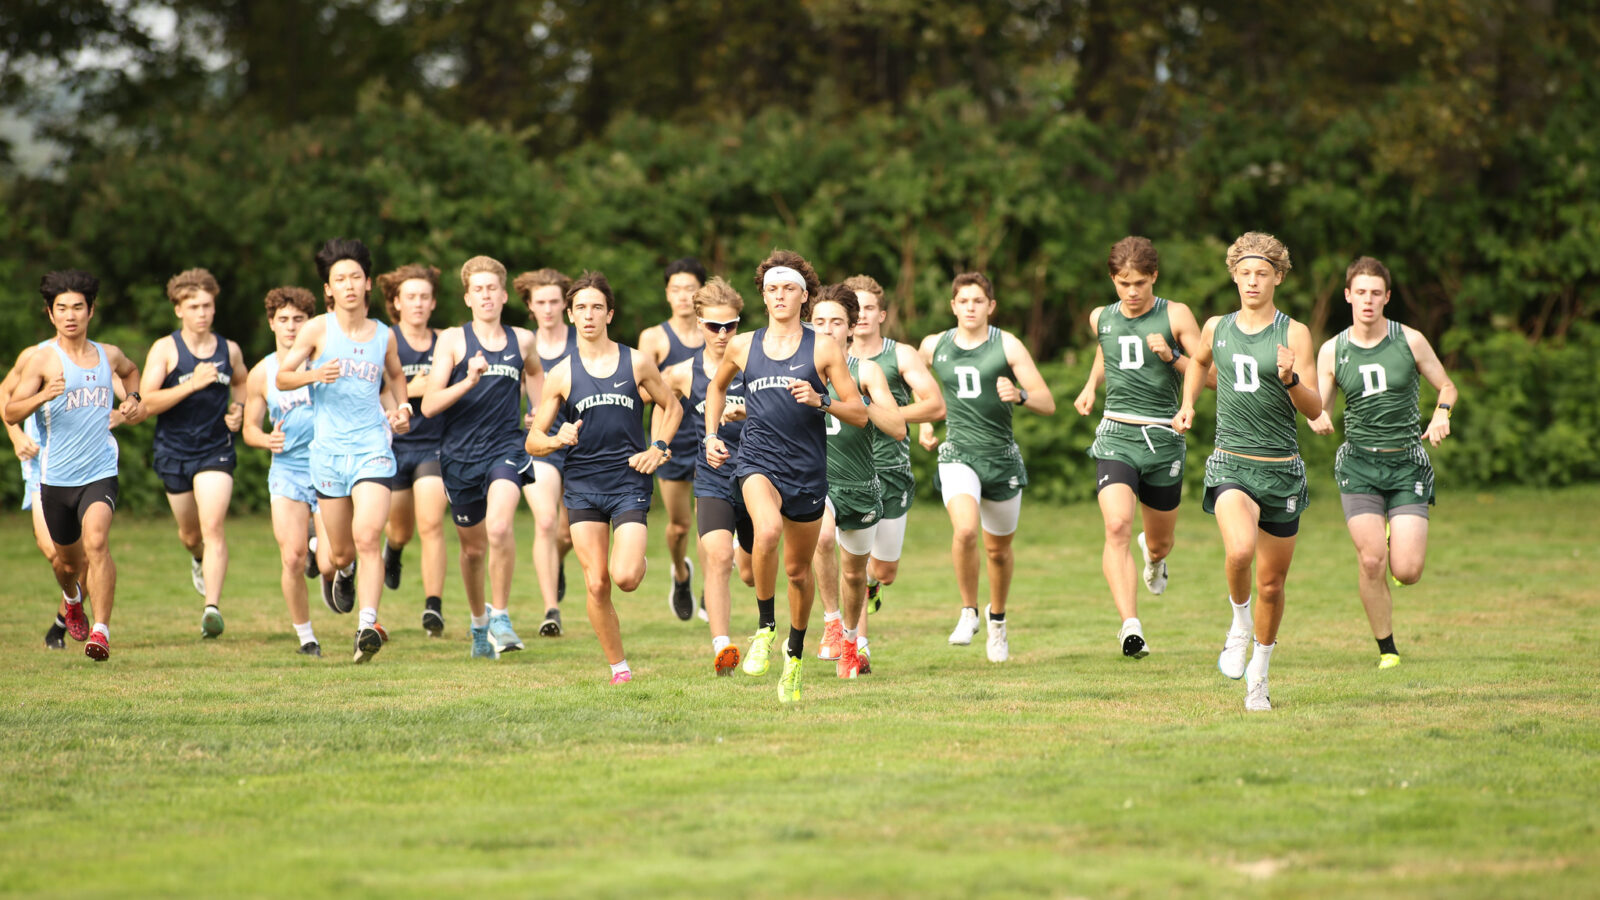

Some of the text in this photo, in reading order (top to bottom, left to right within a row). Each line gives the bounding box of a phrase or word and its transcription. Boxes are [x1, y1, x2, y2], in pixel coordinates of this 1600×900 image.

[1118, 335, 1144, 370] D
[954, 366, 982, 399] D
[1232, 353, 1260, 393] D
[1358, 363, 1387, 398] D
[65, 386, 110, 412] NMH
[575, 393, 634, 414] WILLISTON
